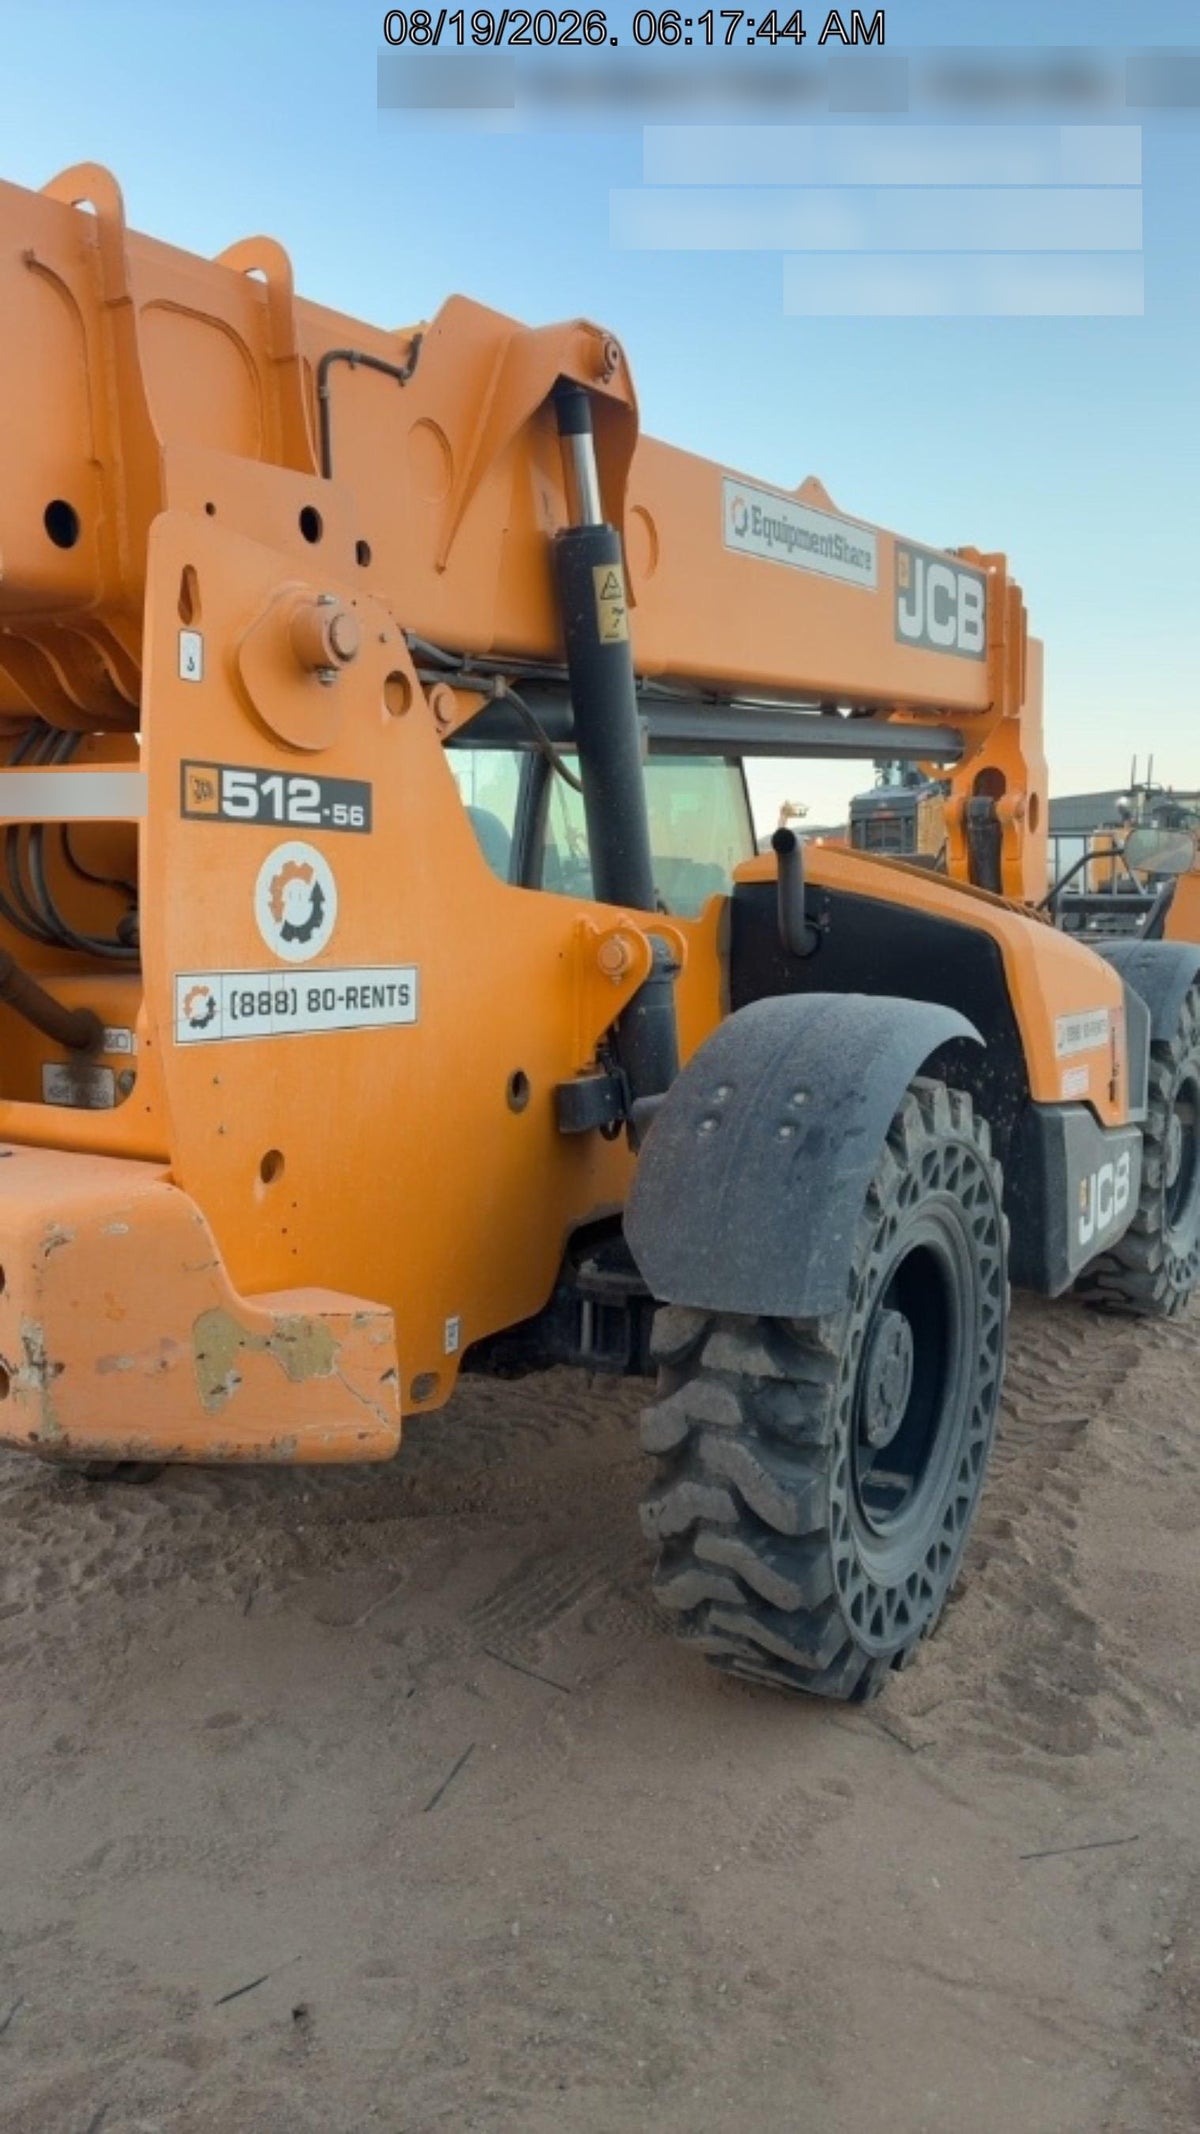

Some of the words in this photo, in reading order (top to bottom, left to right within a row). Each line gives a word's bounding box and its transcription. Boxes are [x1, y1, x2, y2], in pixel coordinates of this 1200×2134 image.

[751, 505, 872, 571] EquipmentShare
[898, 557, 985, 652] JCB
[230, 989, 297, 1020] (888)
[307, 984, 411, 1014] 80-RENTS
[1078, 1150, 1130, 1246] JCB
